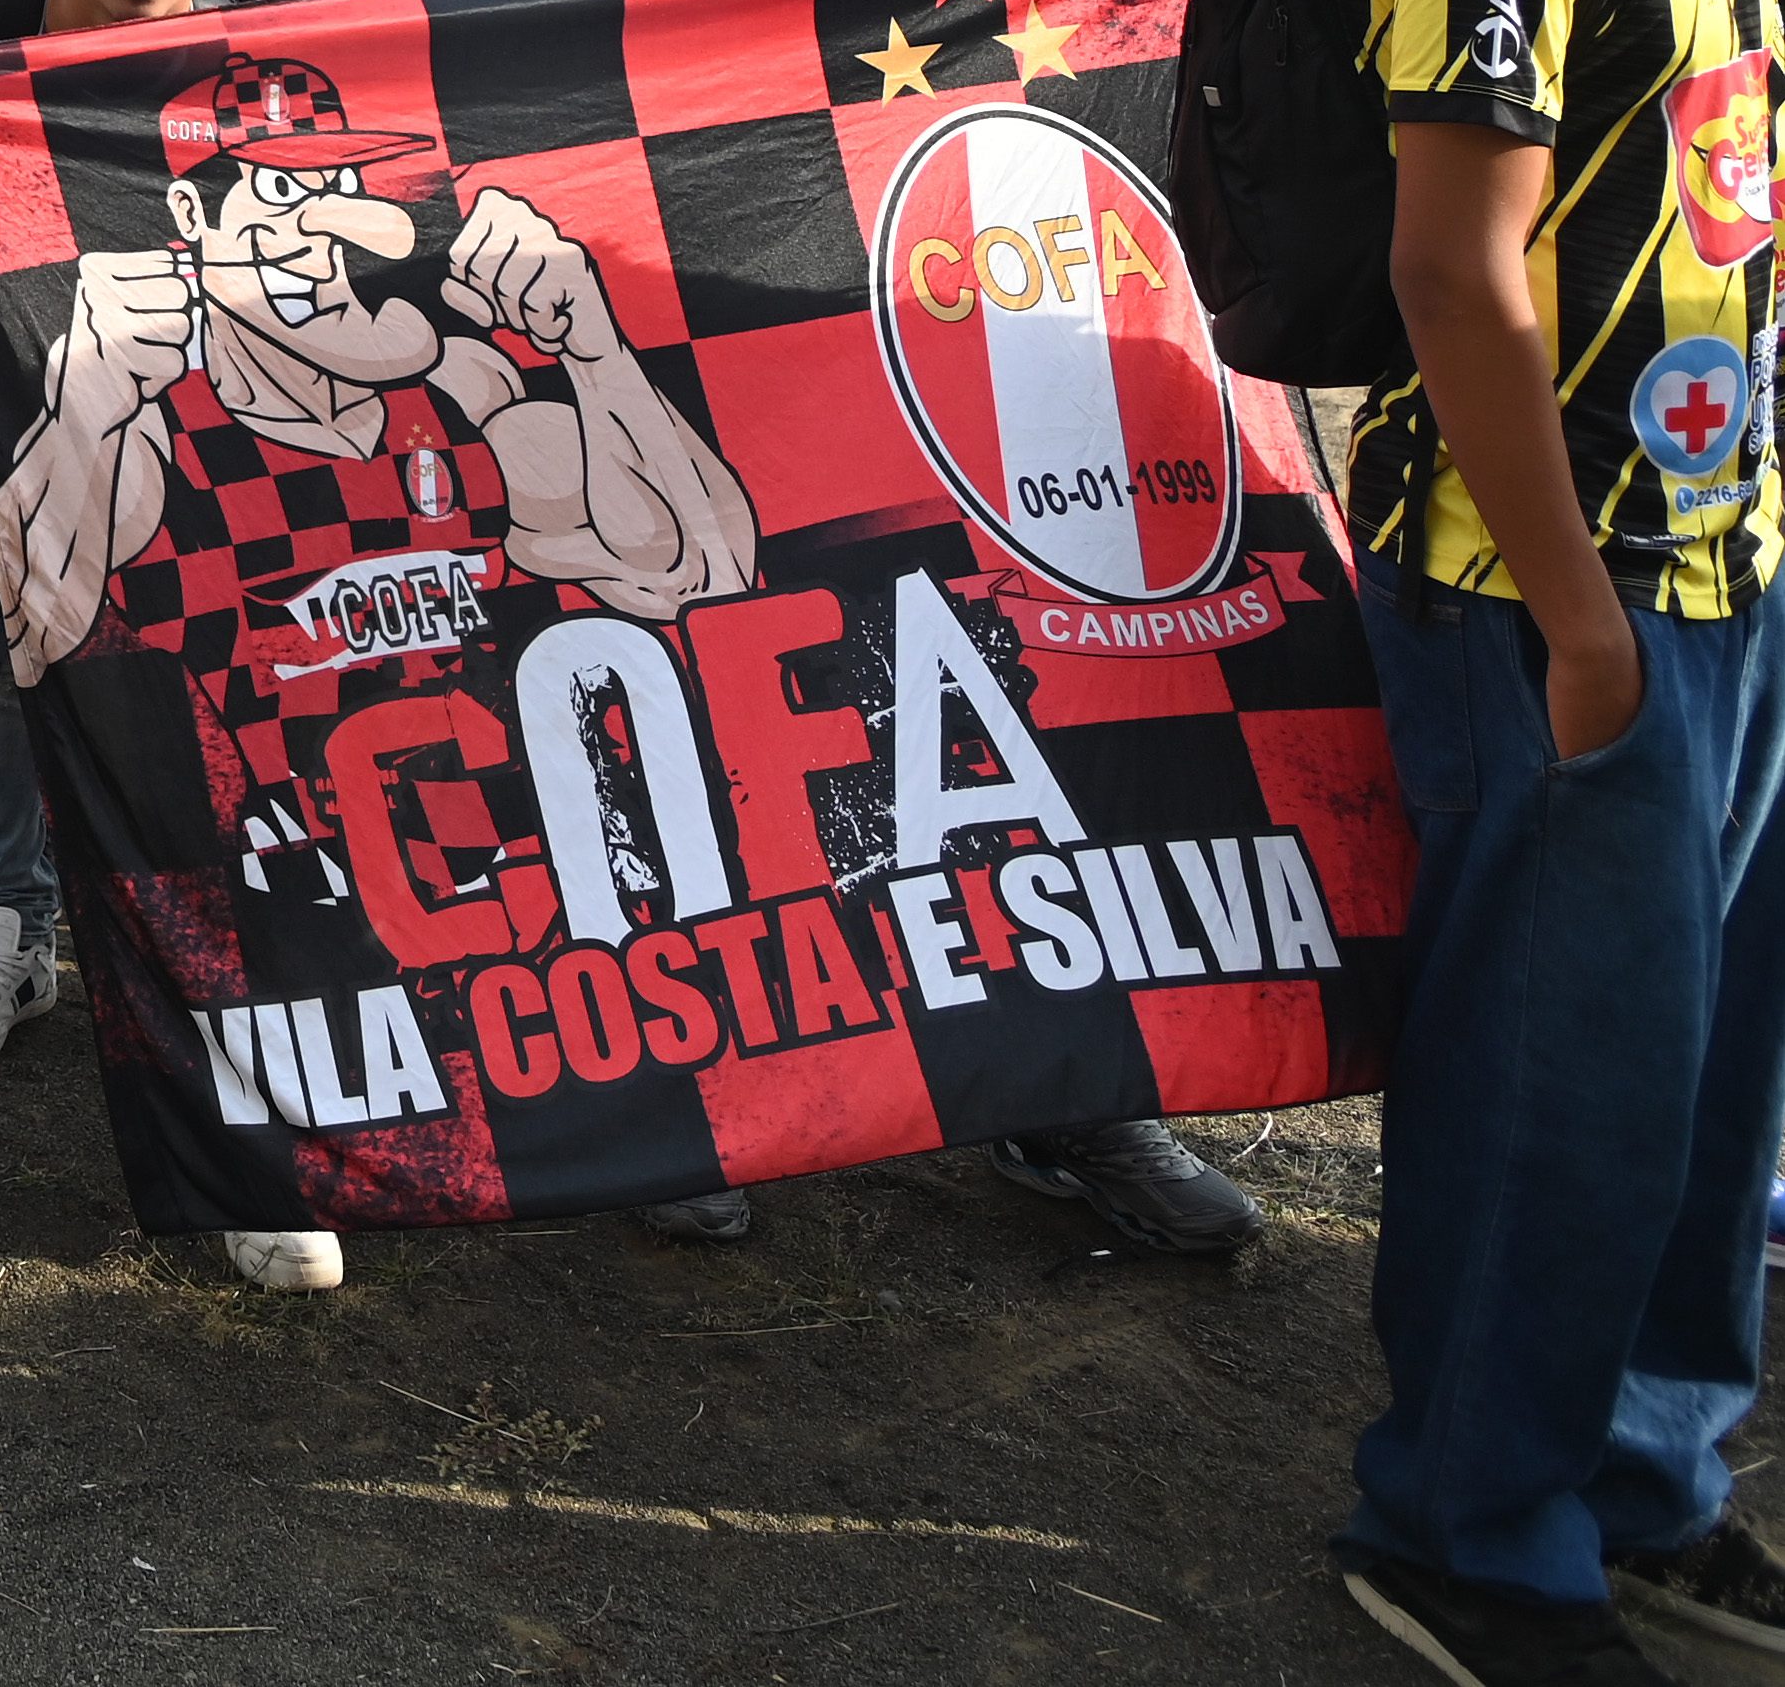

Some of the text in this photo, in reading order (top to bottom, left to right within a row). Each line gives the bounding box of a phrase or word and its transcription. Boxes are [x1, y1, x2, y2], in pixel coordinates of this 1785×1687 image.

[167, 119, 216, 142] COFA
[908, 209, 1168, 324] COFA
[410, 462, 444, 479] COFA
[1017, 458, 1217, 519] 06-01-1999
[334, 562, 491, 654] COFA
[1039, 589, 1269, 650] CAMPINAS
[191, 834, 1343, 1131] VILA COSTA E SILVA
